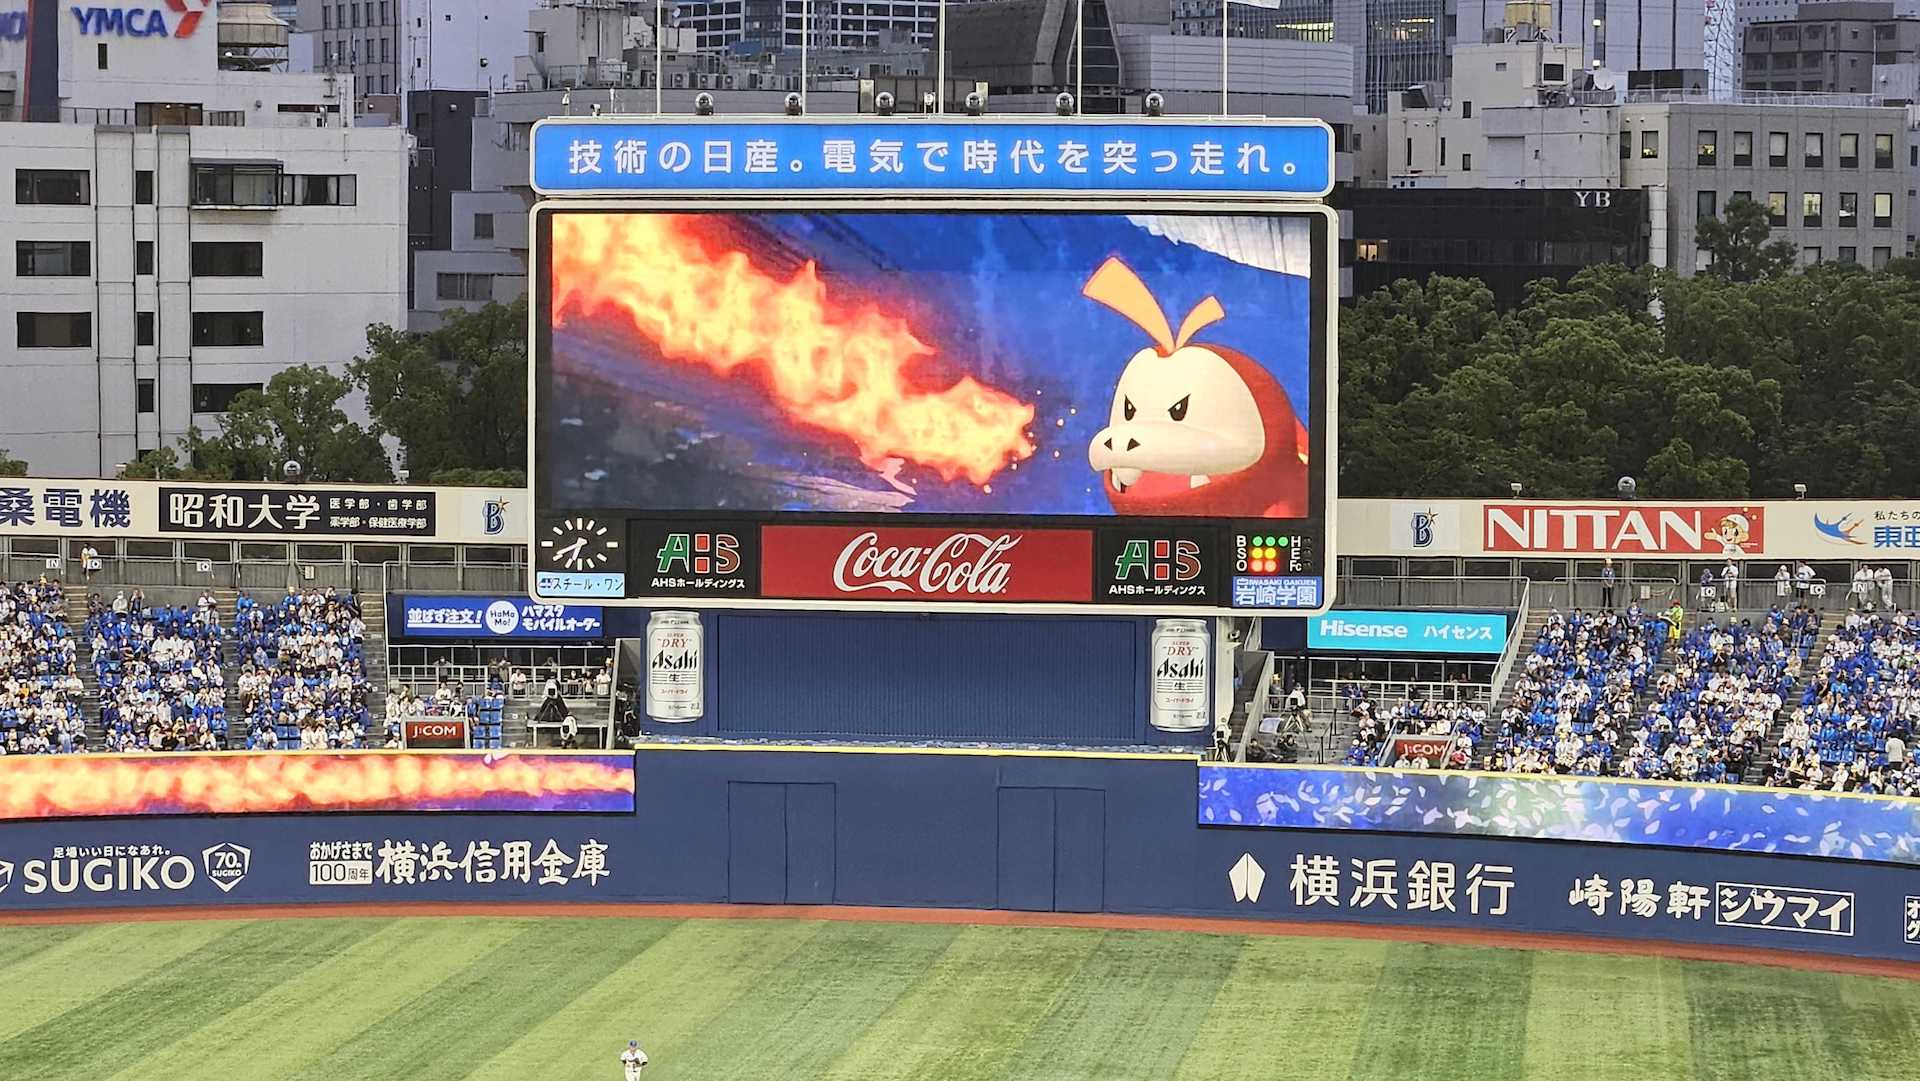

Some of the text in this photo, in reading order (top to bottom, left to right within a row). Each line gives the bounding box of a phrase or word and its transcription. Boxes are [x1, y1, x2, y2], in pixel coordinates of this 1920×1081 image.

[71, 7, 168, 38] YMCA
[1575, 191, 1610, 207] YB
[169, 493, 321, 529] 昭和大学
[1487, 508, 1702, 551] NITTAN
[1236, 535, 1247, 548] B
[1290, 535, 1301, 548] H
[833, 532, 1023, 593] Coca-Cola
[1236, 547, 1247, 560] S
[1290, 547, 1301, 560] E
[1236, 559, 1248, 572] O
[651, 577, 745, 588] AHSホールディングス
[1109, 584, 1206, 595] AHSホールディングス
[1235, 578, 1317, 605] 岩崎学園
[522, 604, 565, 618] ハマスタ
[522, 617, 600, 632] モバイルオーダー
[1320, 620, 1409, 638] Hisense
[1423, 624, 1493, 640] ハイセンス
[652, 649, 698, 670] Asahi
[1156, 657, 1204, 678] Asahi
[412, 725, 457, 737] J:COM
[310, 841, 373, 860] おかげさまで
[375, 838, 611, 887] 横浜信用金庫
[23, 854, 195, 894] SUGIKO
[211, 868, 242, 877] SUGIKO
[311, 863, 369, 882] 100周年
[1289, 853, 1516, 915] 横浜銀行
[1568, 874, 1711, 921] 崎陽軒
